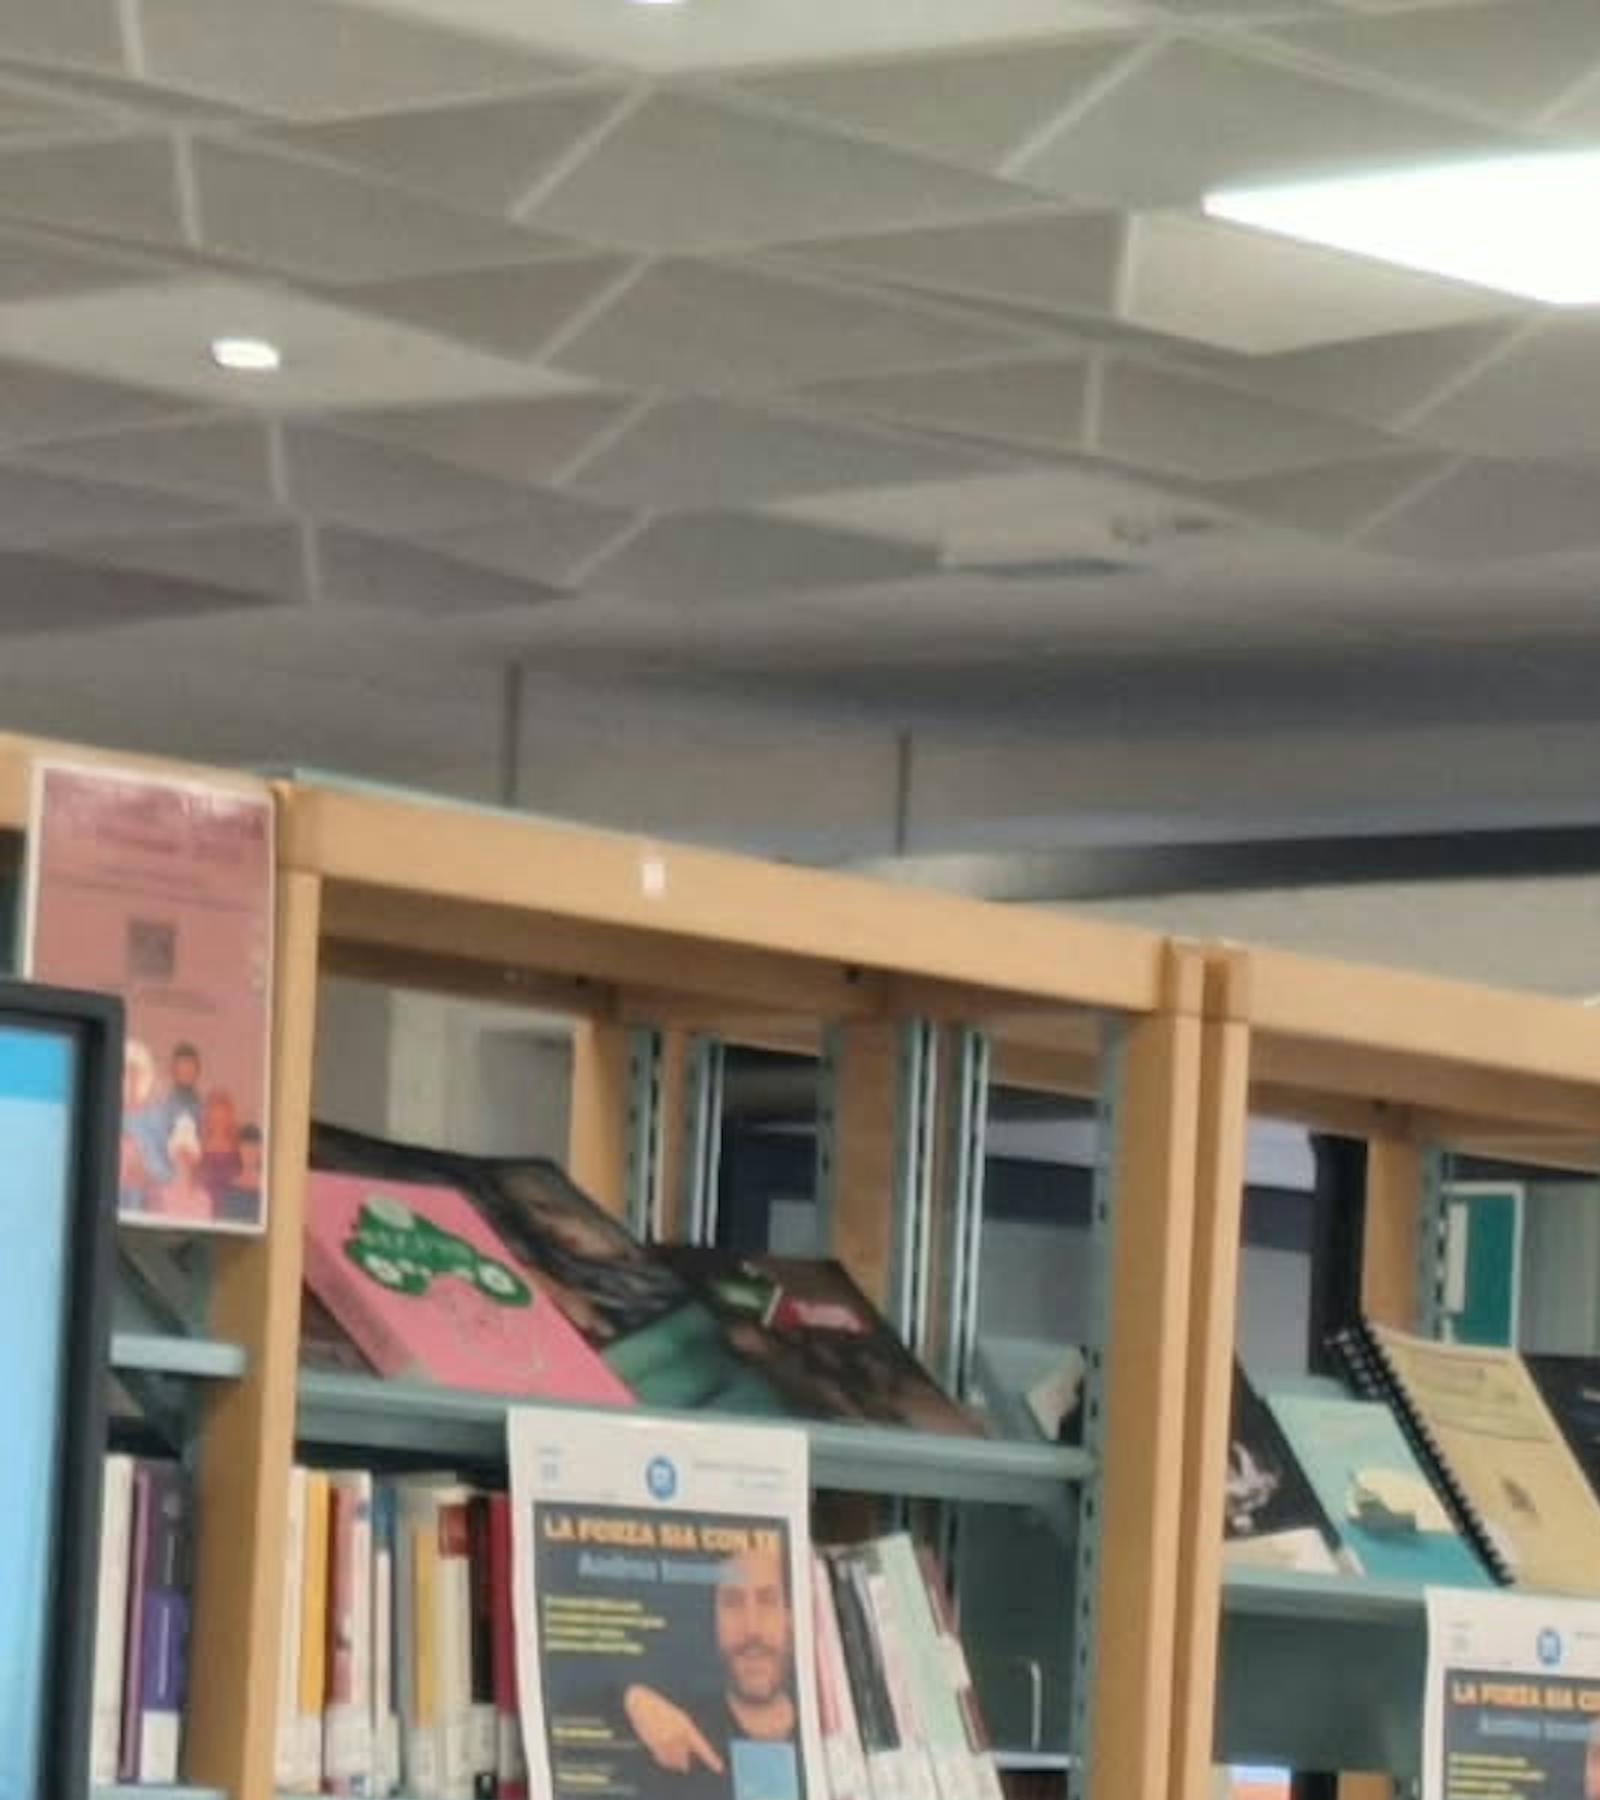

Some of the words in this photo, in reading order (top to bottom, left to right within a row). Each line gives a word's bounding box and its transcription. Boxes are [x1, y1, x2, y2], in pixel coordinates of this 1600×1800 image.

[544, 1516, 574, 1541] LA
[577, 1518, 654, 1547] FORZA
[659, 1523, 697, 1549] SIA
[701, 1526, 747, 1551] CON
[1453, 1680, 1475, 1703] LA
[1480, 1681, 1539, 1709] FORZA
